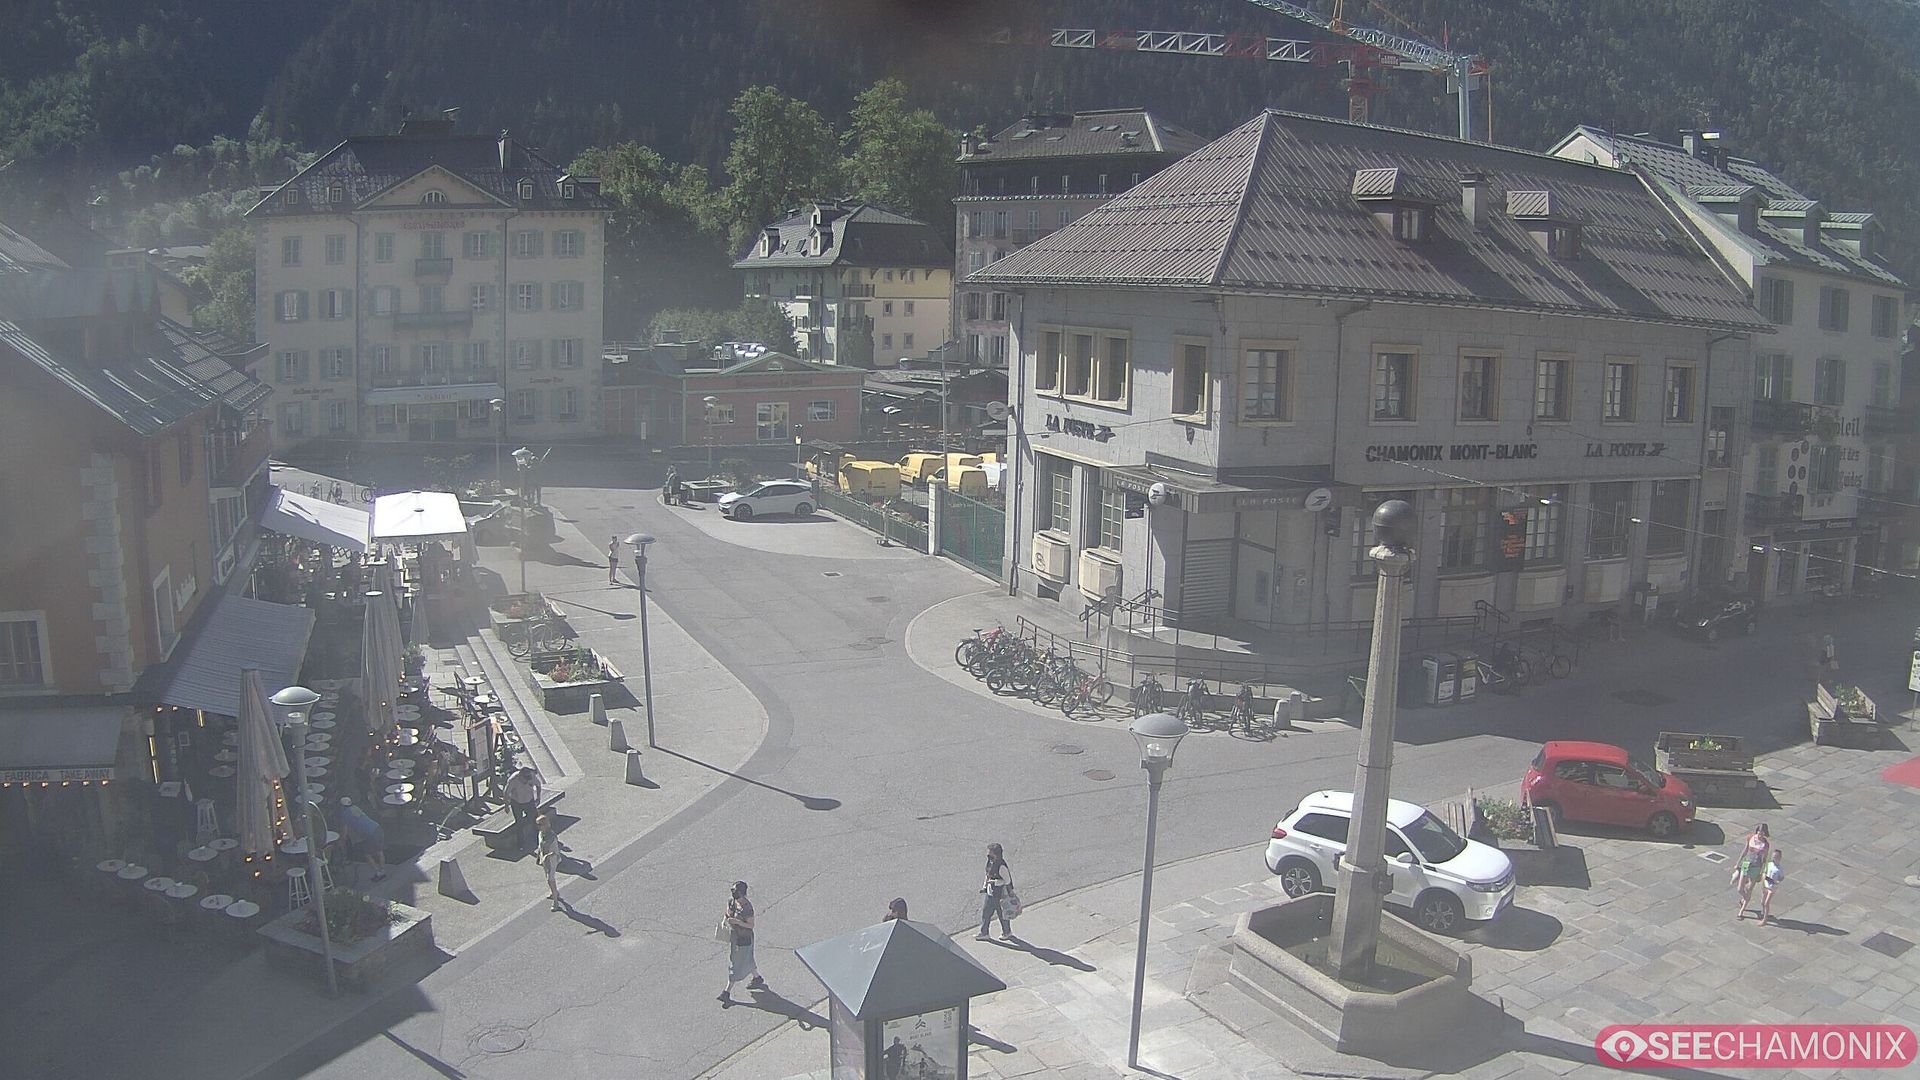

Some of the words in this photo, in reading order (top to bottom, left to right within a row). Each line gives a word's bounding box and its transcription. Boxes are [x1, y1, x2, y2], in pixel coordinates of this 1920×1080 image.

[1045, 413, 1062, 433] LA
[1834, 416, 1860, 437] oleil
[1365, 444, 1444, 463] CHAMONIX
[1449, 442, 1538, 461] MONT-BLANC
[1583, 442, 1604, 458] LA
[1607, 442, 1646, 457] POSTE
[4, 770, 49, 781] FABRICA
